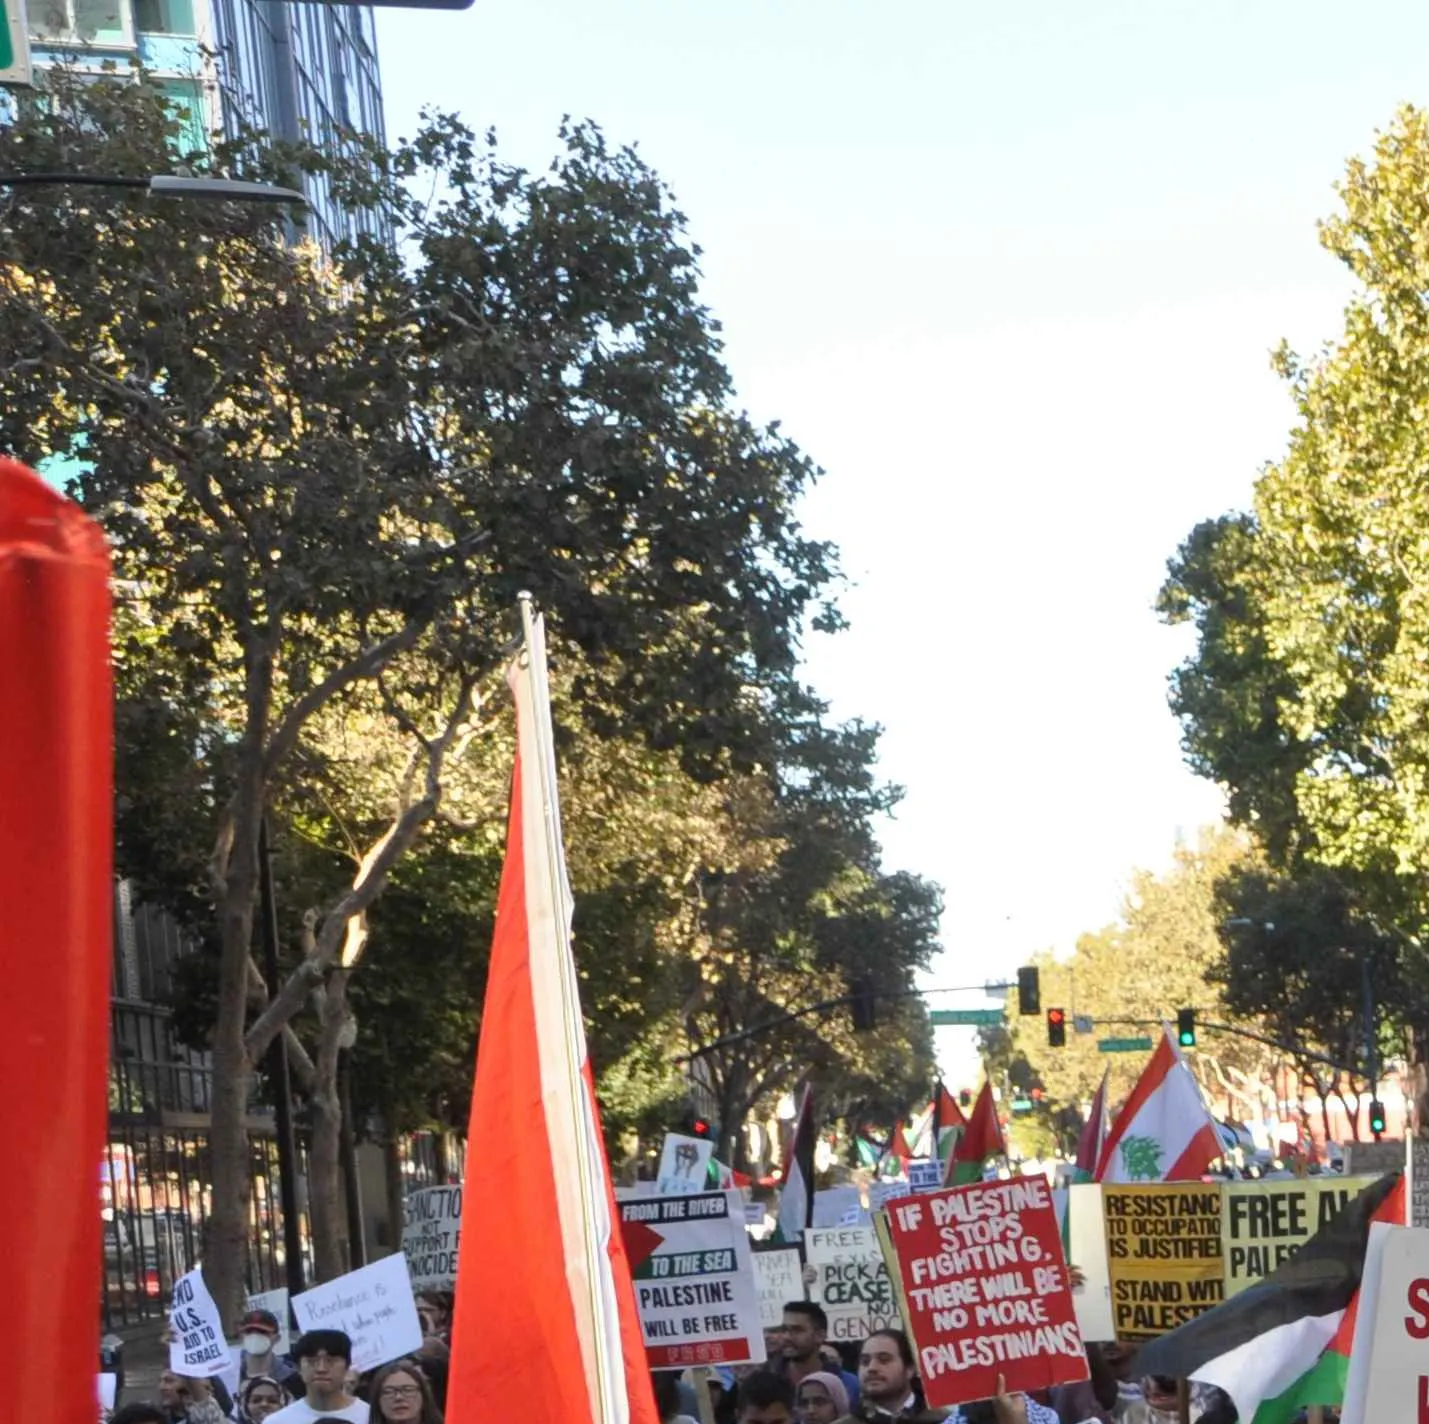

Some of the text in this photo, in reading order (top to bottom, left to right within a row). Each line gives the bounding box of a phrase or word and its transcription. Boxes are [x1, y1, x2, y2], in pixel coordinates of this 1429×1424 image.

[623, 1197, 726, 1222] FROM THE RIVER
[896, 1178, 1050, 1232] IF PALESTINE
[1229, 1191, 1309, 1240] FREE
[812, 1231, 865, 1248] FREE
[939, 1213, 1023, 1252] STOPS
[1108, 1218, 1128, 1237] TO
[1110, 1237, 1129, 1259] IS
[651, 1251, 733, 1275] TO THE SEA
[825, 1263, 869, 1282] PICK
[640, 1280, 734, 1309] PALESTINE
[823, 1281, 890, 1305] CEASE
[909, 1264, 1064, 1312] THERE WILL BE
[1115, 1279, 1182, 1302] STAND
[175, 1308, 207, 1332] U.S.
[644, 1313, 738, 1338] WILL BE FREE
[932, 1298, 1050, 1332] NO MORE
[183, 1326, 216, 1351] AID TO
[184, 1343, 223, 1366] ISRAEL
